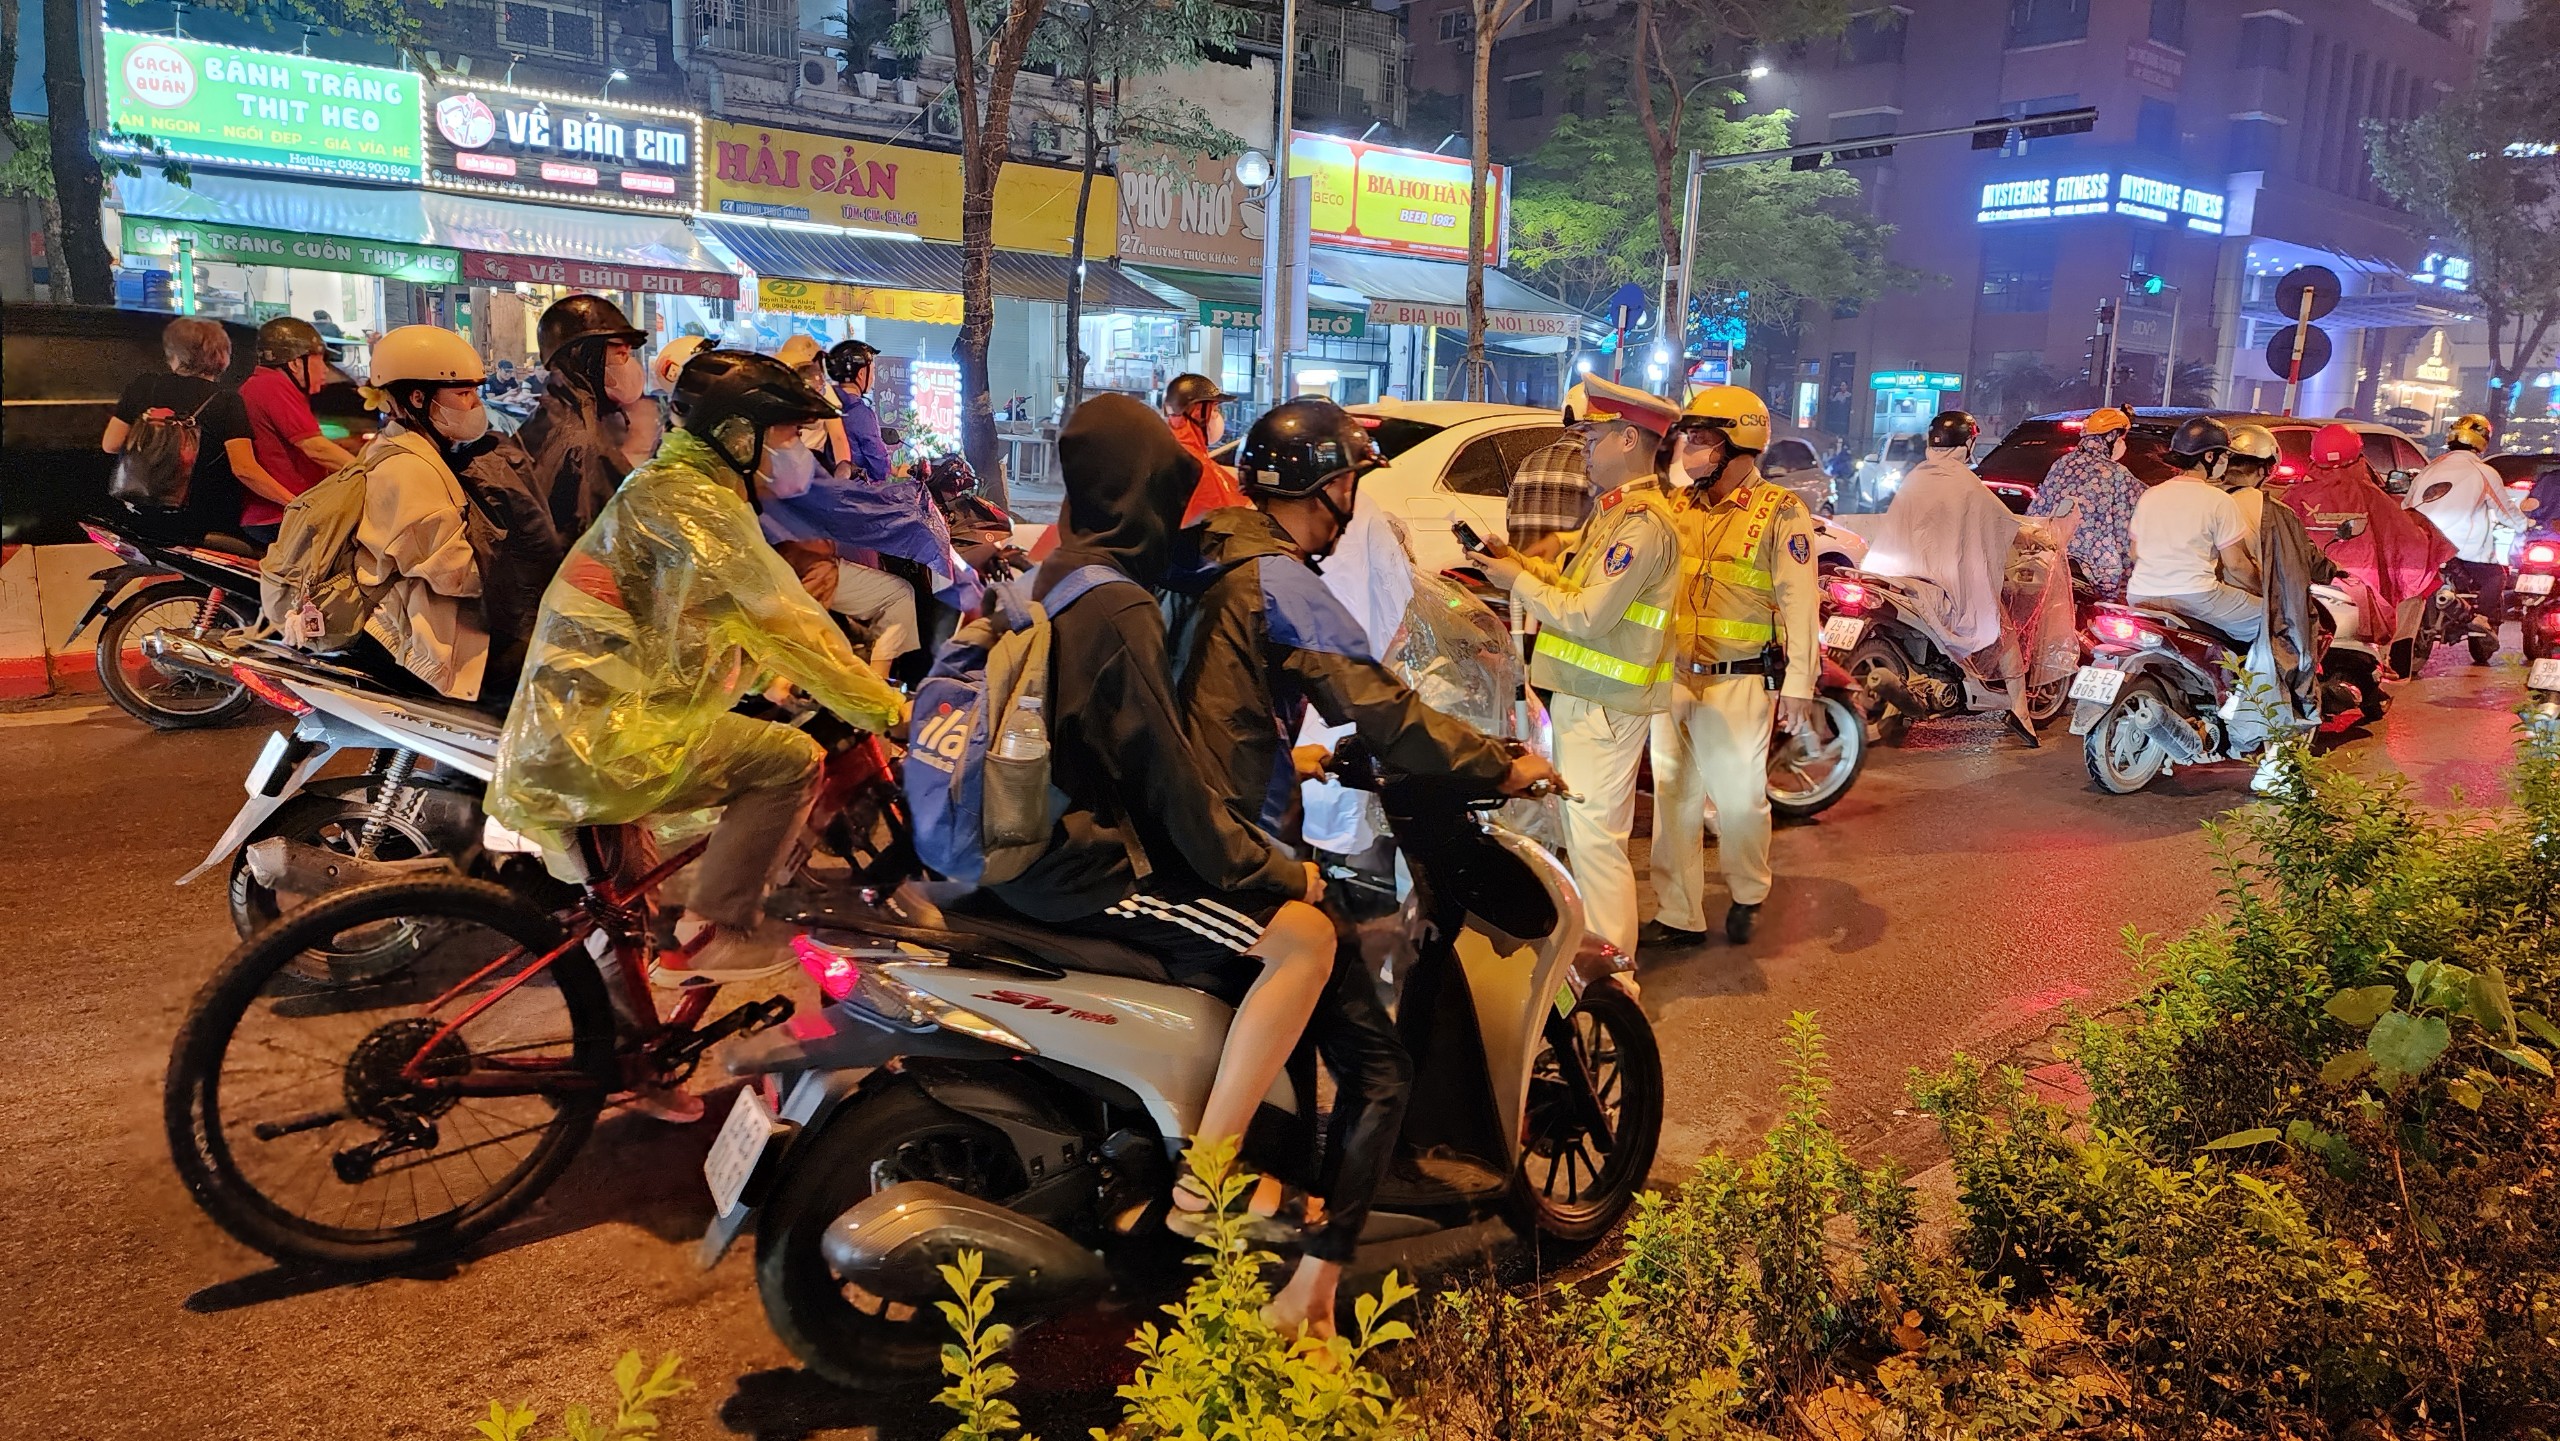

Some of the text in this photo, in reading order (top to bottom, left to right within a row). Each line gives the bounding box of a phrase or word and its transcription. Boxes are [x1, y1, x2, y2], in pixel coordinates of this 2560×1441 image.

[204, 55, 402, 105] BÁNH TRÁNG
[236, 92, 381, 132] THỊT HEO
[151, 116, 201, 133] NGON
[323, 137, 352, 152] GIÁ
[503, 101, 687, 166] VỀ BẢN EM
[288, 152, 411, 177] Hotline: 0862 900 869
[716, 133, 899, 201] HẢI SẢN
[1311, 194, 1345, 206] BECO
[1366, 174, 1396, 196] BIA
[1434, 179, 1458, 205] HÀ
[1981, 172, 2110, 209] MYSTERISE FITNESS
[2119, 173, 2181, 211] MYSTERISE
[2181, 187, 2224, 221] FITNESS
[721, 200, 735, 212] 27
[1399, 208, 1456, 228] BEER 1982
[207, 231, 286, 256] TRÁNG
[359, 247, 409, 269] THỊT
[416, 253, 457, 273] HEO
[1120, 233, 1147, 255] 27A
[1149, 245, 1181, 259] HUỲNH
[1182, 249, 1207, 262] THÚC
[1208, 252, 1239, 265] KHÁNG
[528, 259, 566, 282] VỀ
[642, 273, 684, 292] EM
[773, 281, 802, 295] 27
[910, 294, 962, 320] SẢ
[1373, 302, 1389, 315] 27
[1399, 307, 1427, 324] BIA
[1528, 318, 1565, 334] 1982
